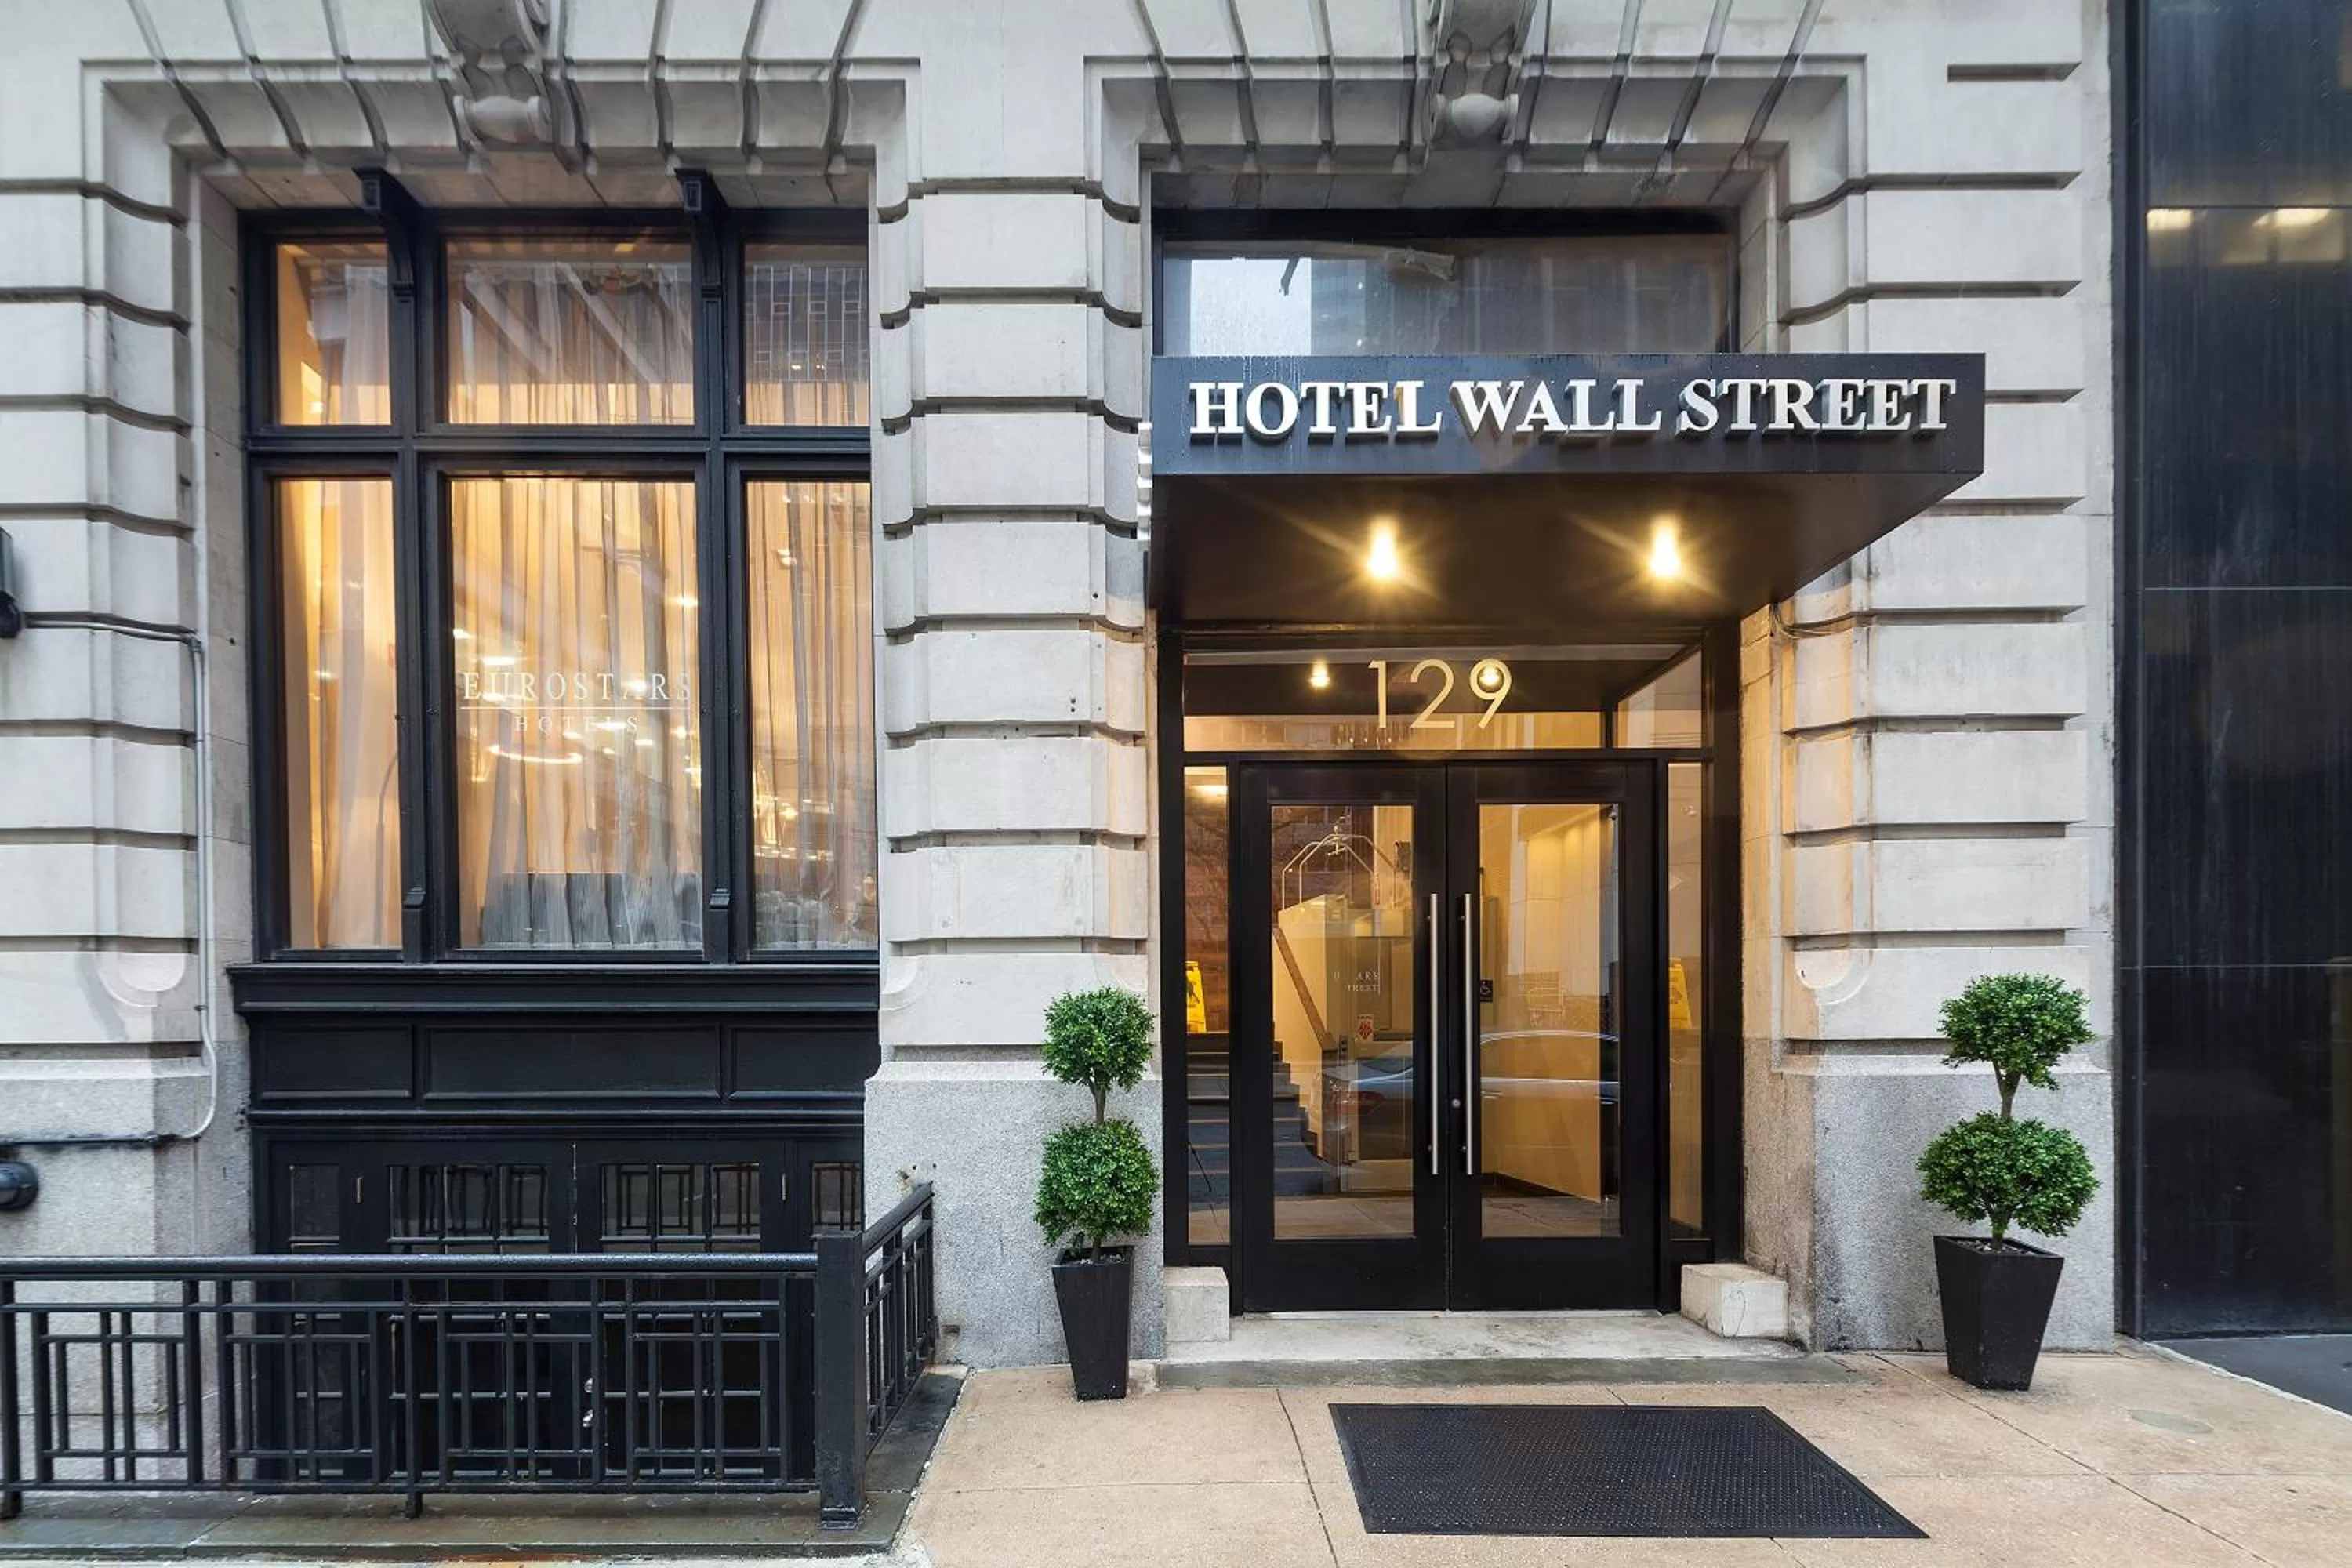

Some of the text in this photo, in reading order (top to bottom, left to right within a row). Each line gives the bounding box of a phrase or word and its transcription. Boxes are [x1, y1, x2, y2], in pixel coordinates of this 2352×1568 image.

[1189, 379, 1956, 434] HOTEL WALL STREET
[1368, 658, 1512, 728] 129
